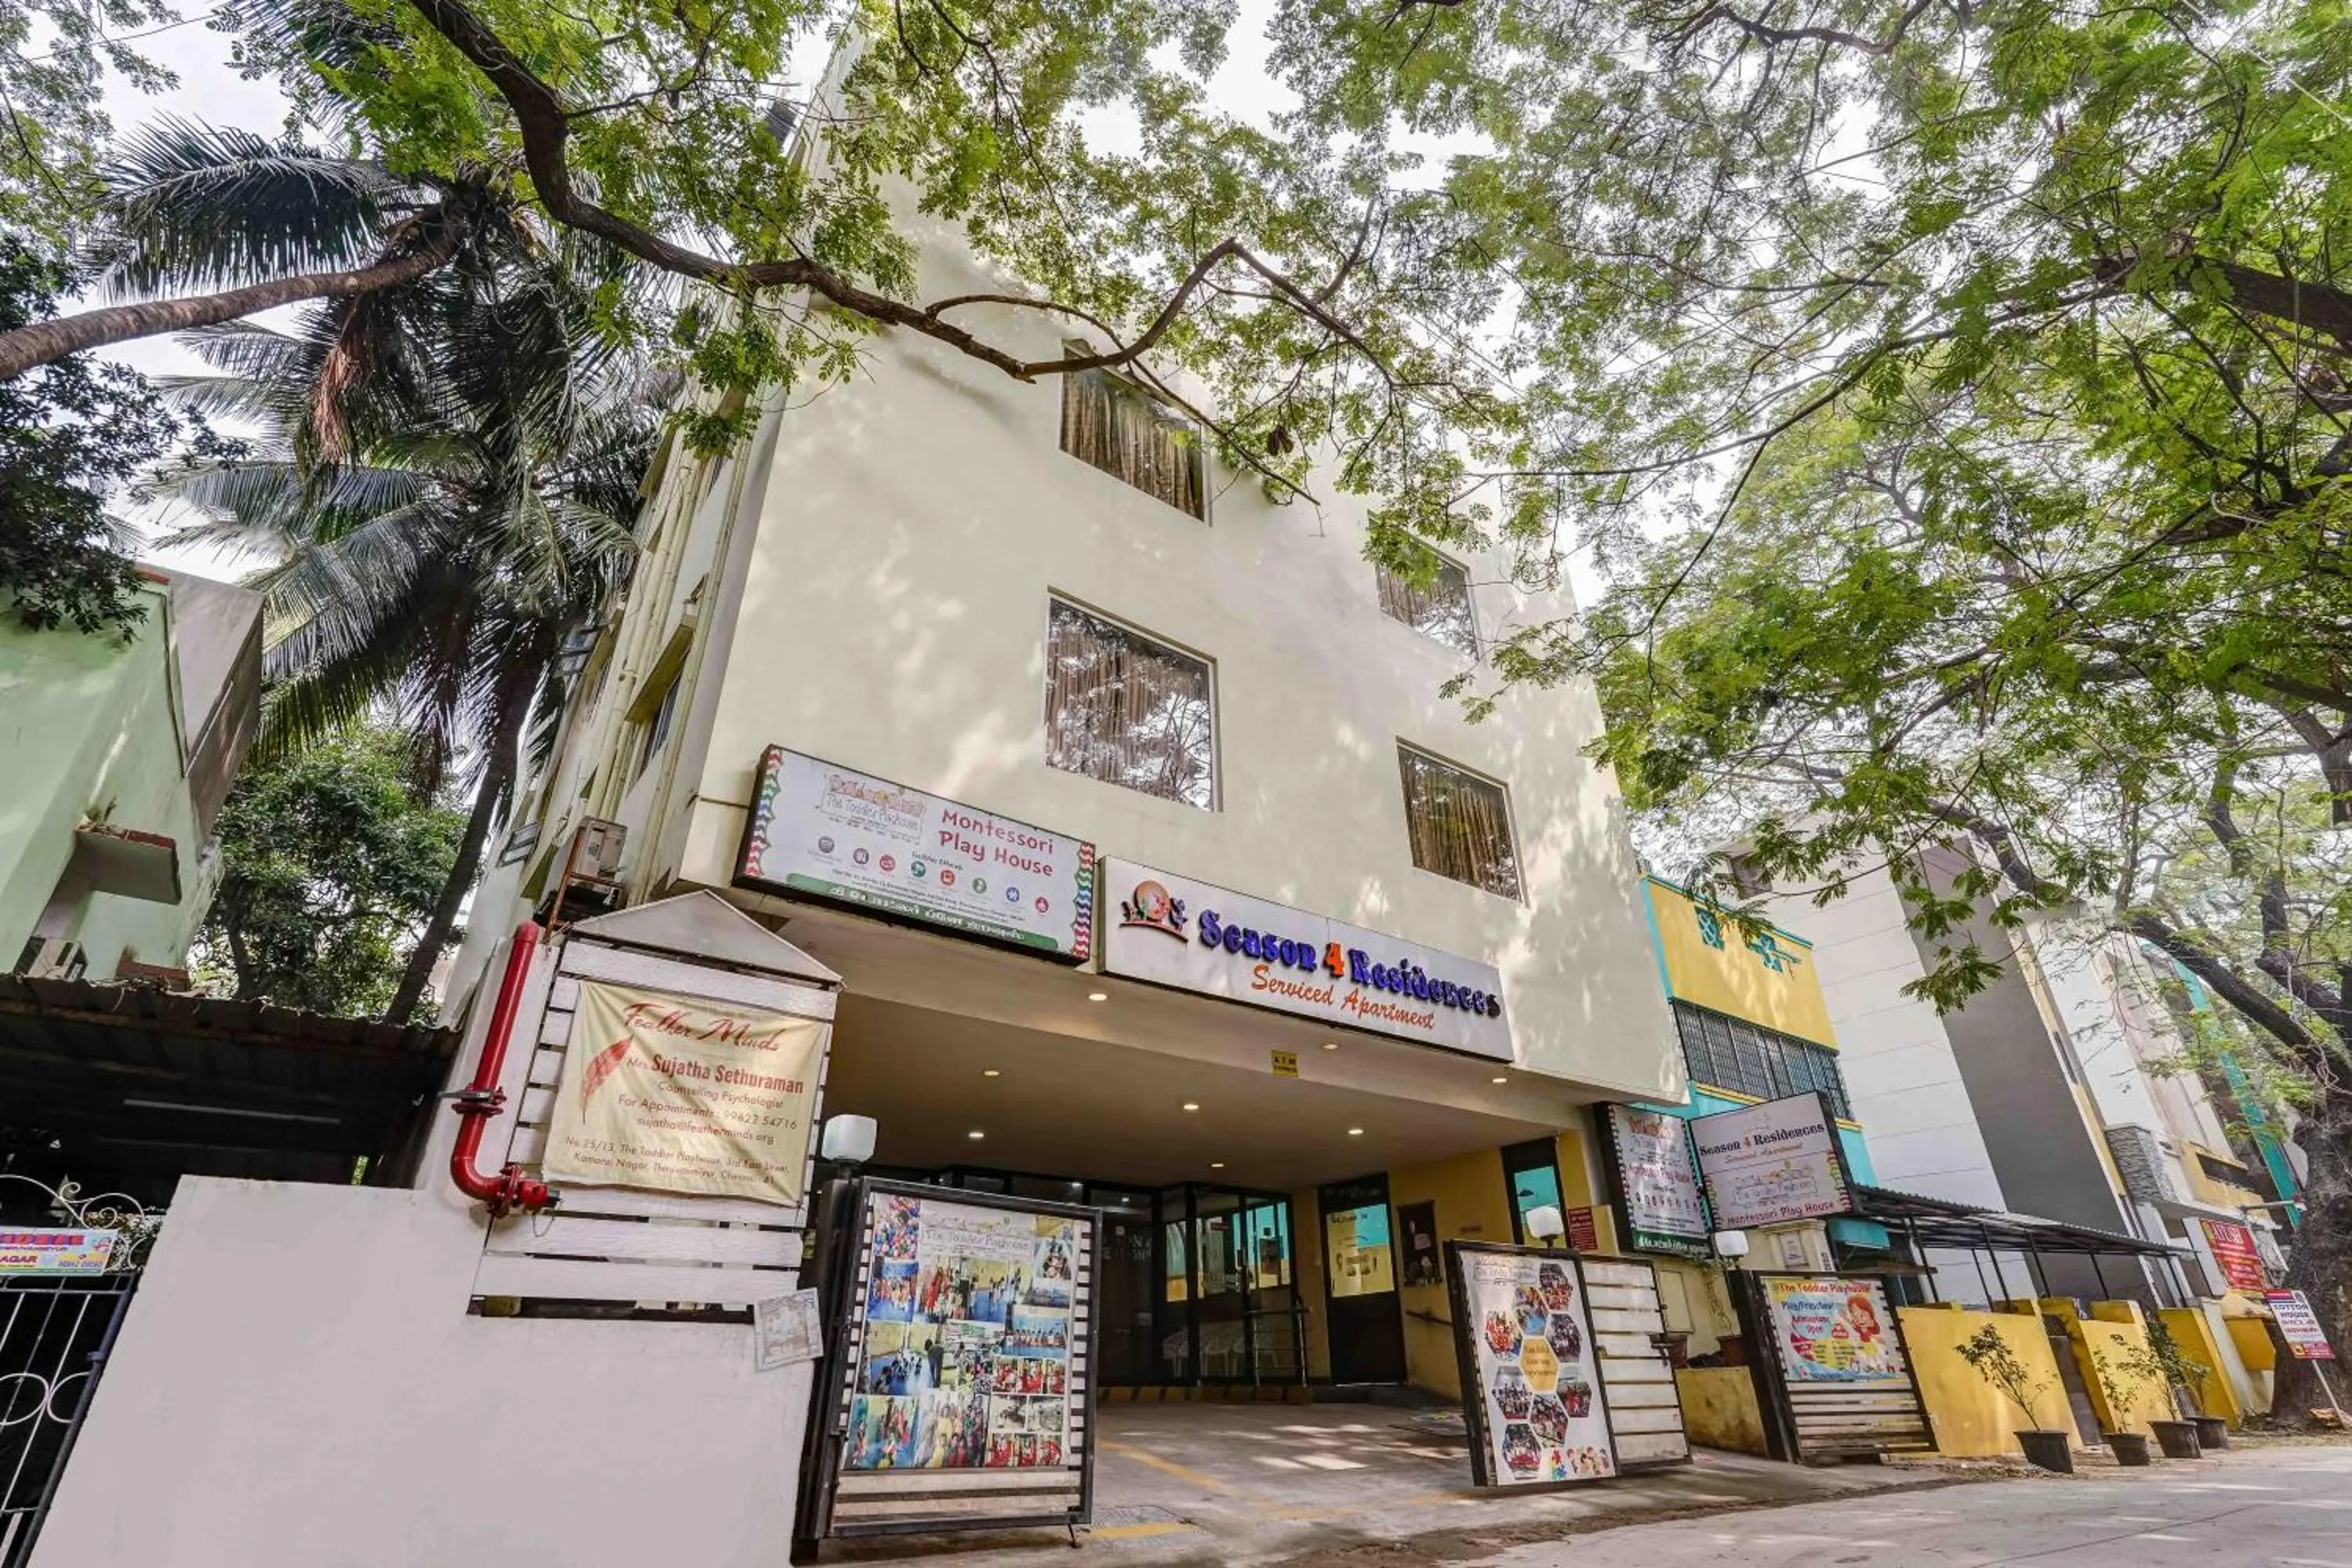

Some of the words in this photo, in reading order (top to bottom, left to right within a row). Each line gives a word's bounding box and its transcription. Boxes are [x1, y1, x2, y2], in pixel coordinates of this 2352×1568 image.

[942, 809, 1053, 854] Montessori
[938, 830, 985, 862] Play
[995, 847, 1053, 877] House
[1200, 909, 1317, 972] Season
[1323, 942, 1345, 978] 4
[1348, 948, 1501, 1018] Residences
[1252, 964, 1334, 1005] Serviced
[1341, 986, 1436, 1029] Apartment
[696, 1018, 786, 1051] Minds
[652, 1054, 710, 1078] Sujatha
[715, 1065, 804, 1094] Sethuraman
[619, 1094, 637, 1107] For
[762, 1115, 797, 1131] 54716
[721, 1091, 784, 1109] Psychologist
[621, 1144, 636, 1155] The
[1699, 1141, 1741, 1156] Season
[1752, 1123, 1825, 1145] Residences
[1780, 1205, 1802, 1218] Play
